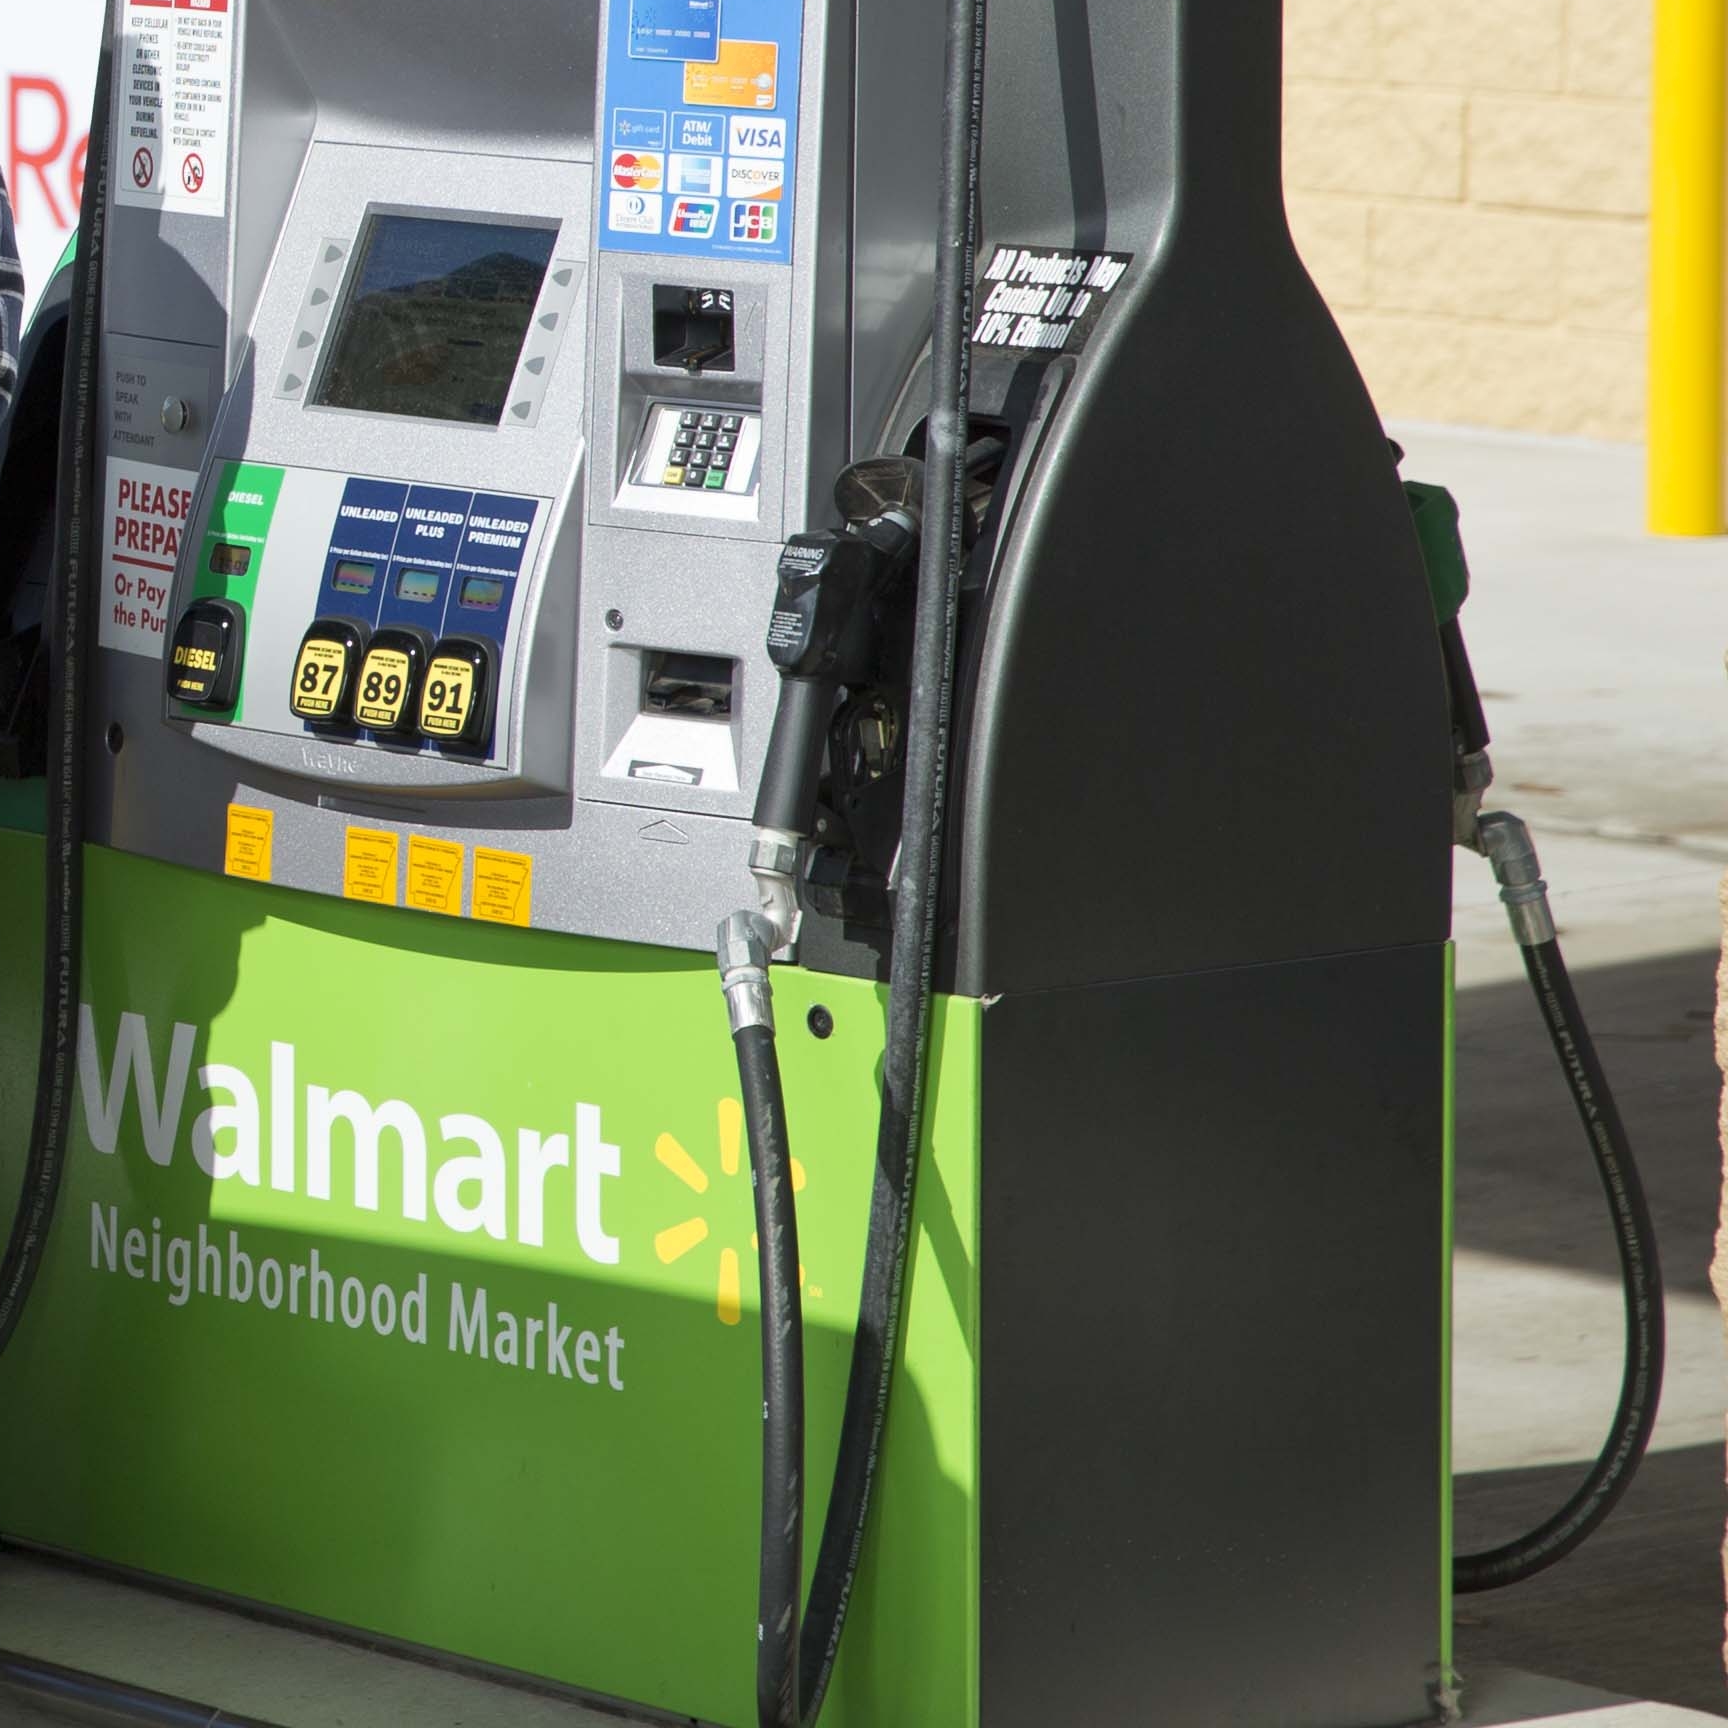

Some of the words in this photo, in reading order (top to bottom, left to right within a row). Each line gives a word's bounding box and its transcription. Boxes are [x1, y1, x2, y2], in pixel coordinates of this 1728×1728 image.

[133, 79, 153, 91] DEVICES
[129, 95, 141, 106] YOUR
[143, 96, 163, 108] VEHICLE
[136, 111, 155, 123] DURING
[682, 119, 712, 133] ATM/
[646, 124, 661, 134] card
[736, 128, 782, 148] VISA
[682, 133, 713, 147] Debit
[613, 163, 662, 178] MasterCard
[731, 168, 780, 182] DISCOVER
[733, 214, 774, 231] JCB
[984, 248, 1017, 280] All
[1009, 250, 1088, 285] Products
[1082, 255, 1127, 292] May
[984, 281, 1050, 315] Contain
[1044, 285, 1073, 320] Up
[1068, 289, 1092, 318] to
[971, 312, 1016, 345] 10%
[1008, 315, 1076, 349] Ethanol
[959, 289, 972, 393] FUTURA
[116, 372, 135, 385] PUSH
[135, 374, 146, 387] TO
[115, 391, 139, 405] SPEAK
[114, 410, 132, 424] WITH
[112, 430, 155, 448] ATTENDANT
[118, 477, 192, 521] PLEASE
[227, 490, 265, 506] DIESEL
[340, 505, 399, 523] UNLEADED
[405, 507, 464, 525] UNLEADED
[415, 524, 445, 539] PLUS
[469, 515, 530, 533] UNLEADED
[114, 516, 183, 558] PREPA
[468, 531, 522, 549] PREMIUM
[784, 545, 825, 561] WARNING
[114, 573, 133, 596] Or
[137, 580, 167, 610] Pay
[65, 559, 79, 653] FUTURA
[113, 602, 137, 627] the
[174, 645, 217, 671] DIESEL
[299, 662, 339, 695] 87
[362, 671, 402, 706] 89
[427, 679, 463, 714] 91
[932, 726, 946, 831] FUTURA
[56, 957, 71, 1047] FUTURA
[1558, 1028, 1598, 1121] FUTURA
[76, 1002, 621, 1265] Walmart
[893, 1157, 915, 1255] FUTURA
[90, 1201, 428, 1346] Neighborhood
[448, 1282, 625, 1392] Market
